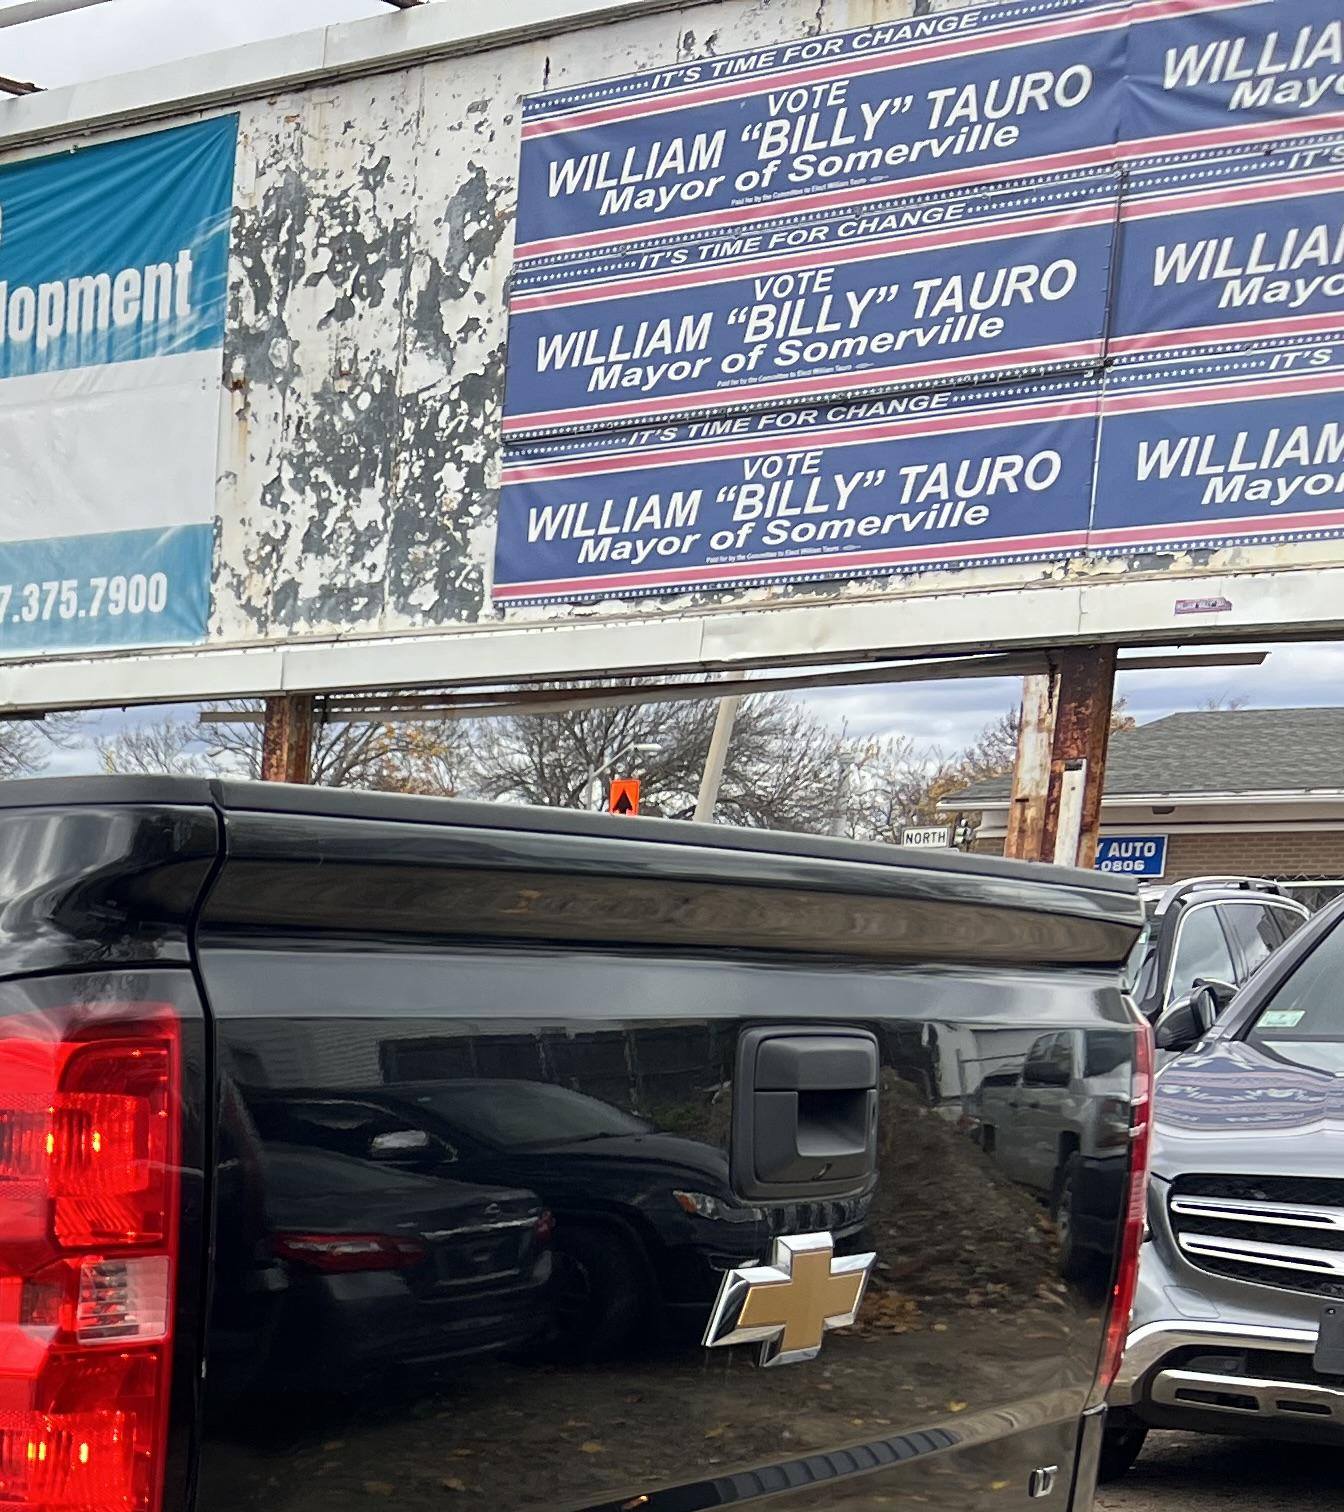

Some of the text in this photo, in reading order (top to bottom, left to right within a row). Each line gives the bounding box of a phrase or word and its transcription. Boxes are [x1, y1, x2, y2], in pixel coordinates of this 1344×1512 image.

[651, 11, 984, 89] IT'S TIME FOR CHANGE
[548, 64, 1094, 198] WILLIAM "BILLY" TAURO
[768, 81, 850, 117] VOTE
[599, 123, 1020, 217] Mayor of Somerville
[638, 203, 968, 270] IT'S TIME FOR CHANGE
[1154, 223, 1344, 286] WILLIA
[536, 259, 1077, 373] WILLIAM "BILLY" TAURO
[753, 268, 836, 301] VOTE
[586, 313, 1005, 393] Mayor of Somerville
[1269, 348, 1333, 370] IT'S
[628, 392, 951, 446] IT'S TIME FOR CHANGE
[527, 450, 1062, 543] WILLIAM "BILLY" TAURO
[743, 451, 824, 481] VOTE
[576, 500, 990, 565] Mayor of Somerville
[906, 831, 946, 844] NORTH
[1108, 842, 1156, 857] AUTO
